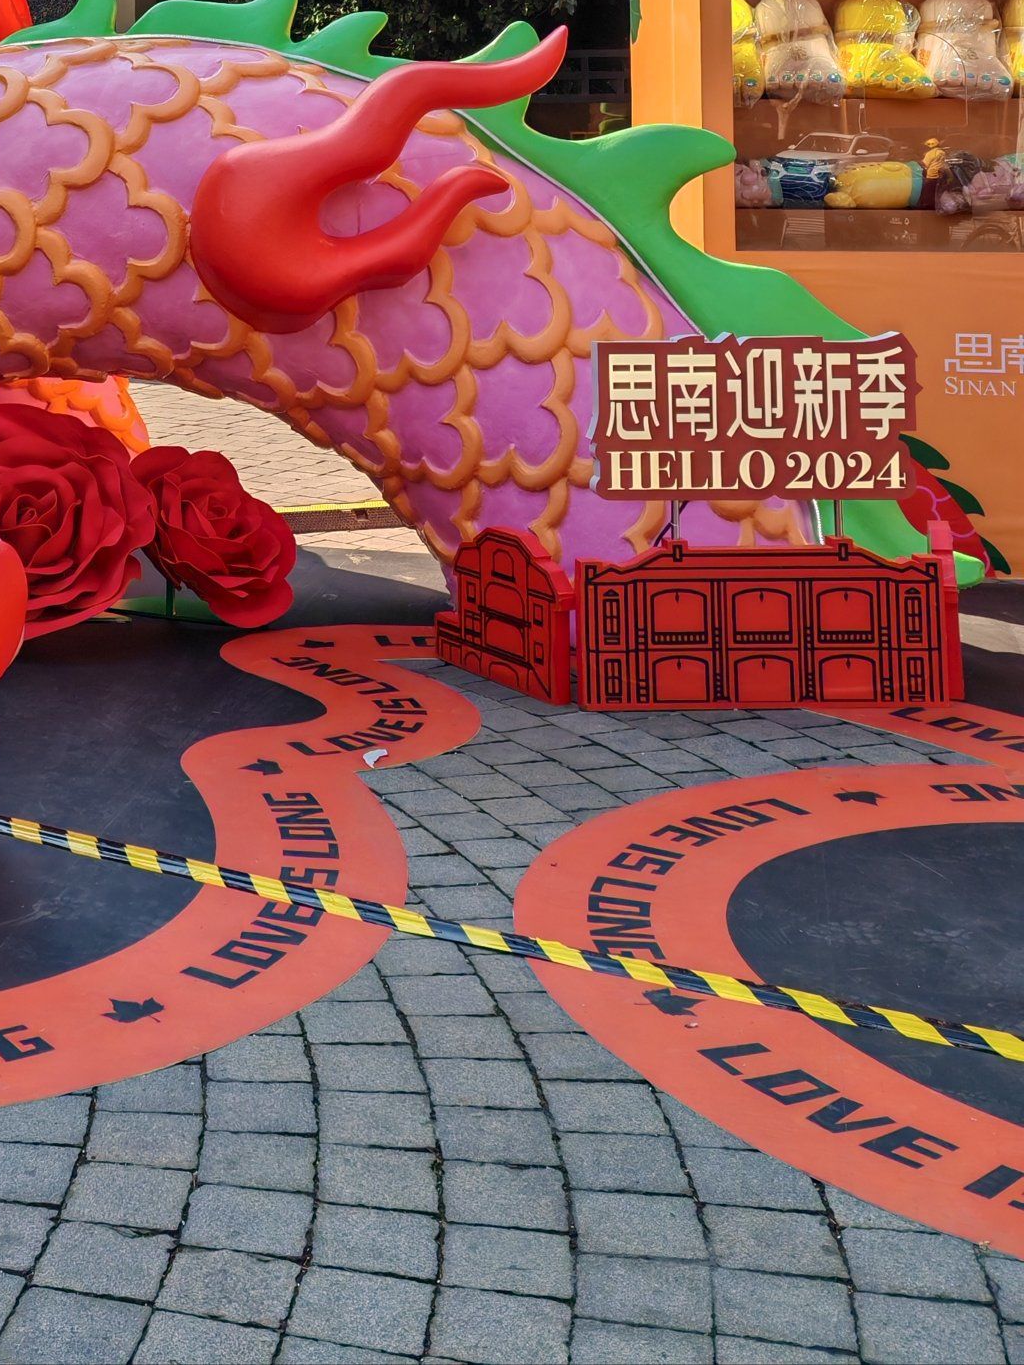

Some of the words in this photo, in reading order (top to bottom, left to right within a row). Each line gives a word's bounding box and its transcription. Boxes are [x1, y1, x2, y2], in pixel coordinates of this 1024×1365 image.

[606, 346, 907, 442] 思南迎新季
[945, 377, 1016, 396] SINAN
[606, 449, 776, 491] HELLO
[784, 450, 907, 490] 2024
[271, 656, 399, 695] LONG
[372, 697, 428, 716] IS
[287, 719, 425, 756] LOVE
[262, 792, 340, 860] LONG
[649, 798, 812, 847] LOVE
[279, 866, 340, 893] S
[606, 843, 686, 876] IS
[179, 901, 324, 989] LOVE
[696, 1042, 961, 1170] LOVE
[962, 1164, 1024, 1211] I
